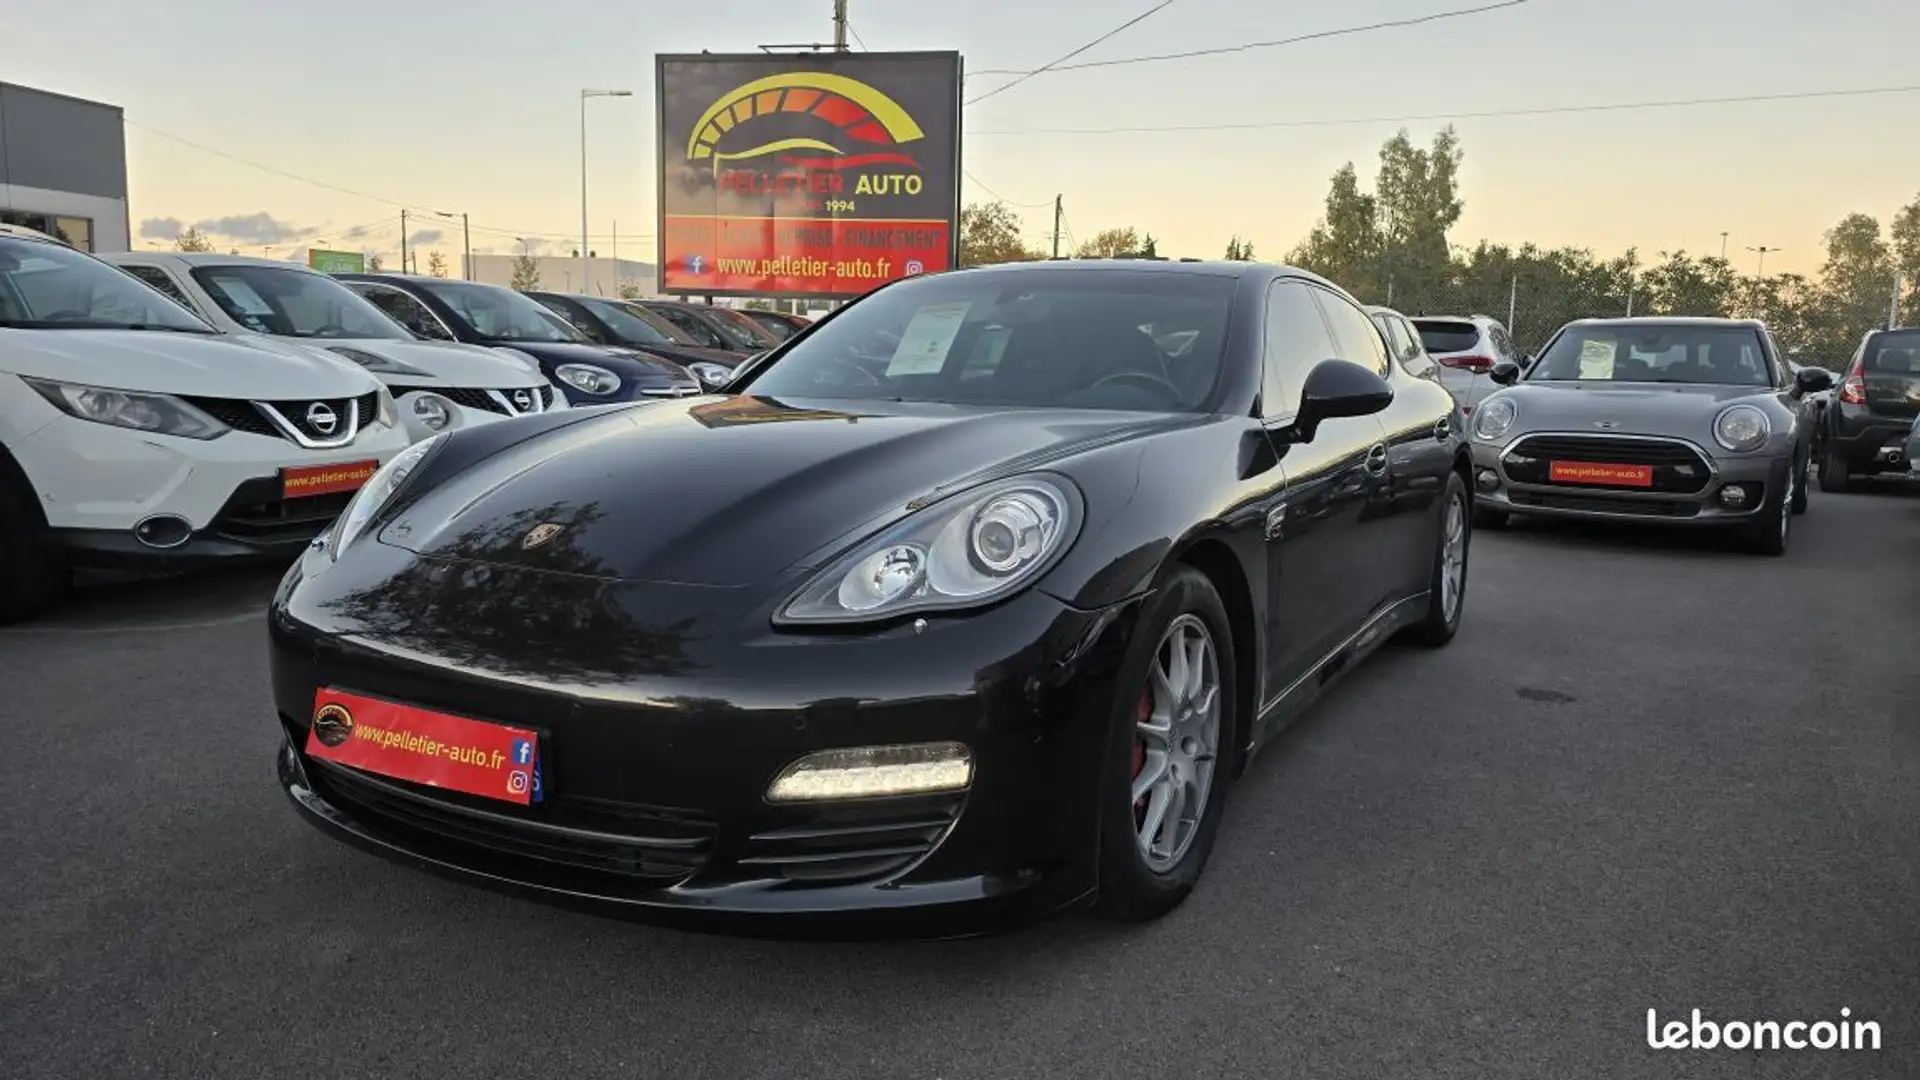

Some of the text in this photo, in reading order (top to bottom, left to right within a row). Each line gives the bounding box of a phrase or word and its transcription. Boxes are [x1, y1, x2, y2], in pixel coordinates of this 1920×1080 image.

[855, 174, 923, 195] AUTO
[825, 200, 855, 212] 1994
[845, 228, 942, 249] FINANCEMENT
[717, 254, 891, 280] www.pelletier-auto.fr
[354, 722, 506, 770] www.pelletier-auto.fr
